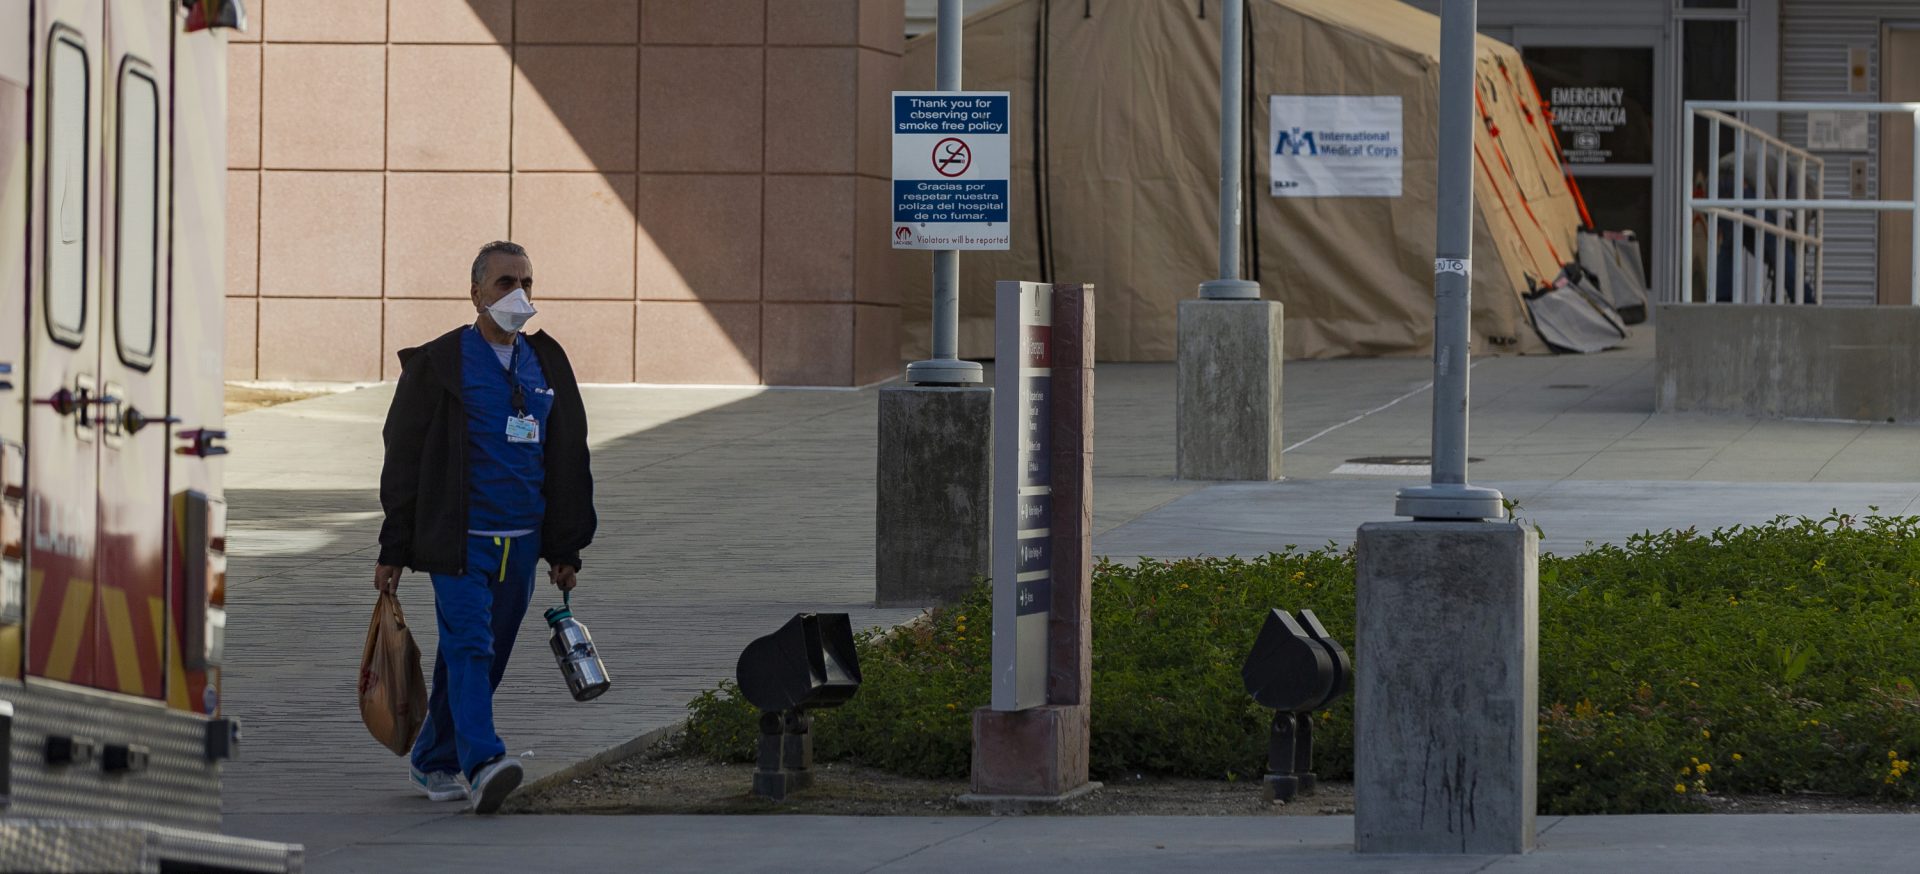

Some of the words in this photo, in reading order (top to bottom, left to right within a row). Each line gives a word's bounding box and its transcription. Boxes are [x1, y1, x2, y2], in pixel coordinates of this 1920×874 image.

[1551, 87, 1624, 106] EMERGENCY
[910, 98, 948, 108] Thank
[950, 100, 972, 109] you
[975, 98, 992, 108] for
[910, 110, 968, 121] observing
[971, 111, 991, 119] our
[1552, 106, 1626, 125] EMERGENCIA
[899, 121, 939, 130] smoke
[941, 121, 965, 130] free
[968, 121, 1003, 132] policy
[1319, 131, 1390, 141] International
[1320, 144, 1363, 156] Medical
[1366, 144, 1398, 158] Corps
[917, 182, 963, 191] Gracias
[965, 183, 986, 192] por
[903, 193, 952, 202] respetar
[937, 202, 955, 210] del
[958, 202, 1004, 212] hospital
[914, 211, 929, 220] de
[950, 212, 988, 220] fumar.
[917, 234, 950, 245] Violators
[951, 234, 964, 244] will
[965, 234, 975, 244] be
[976, 234, 1009, 246] reported
